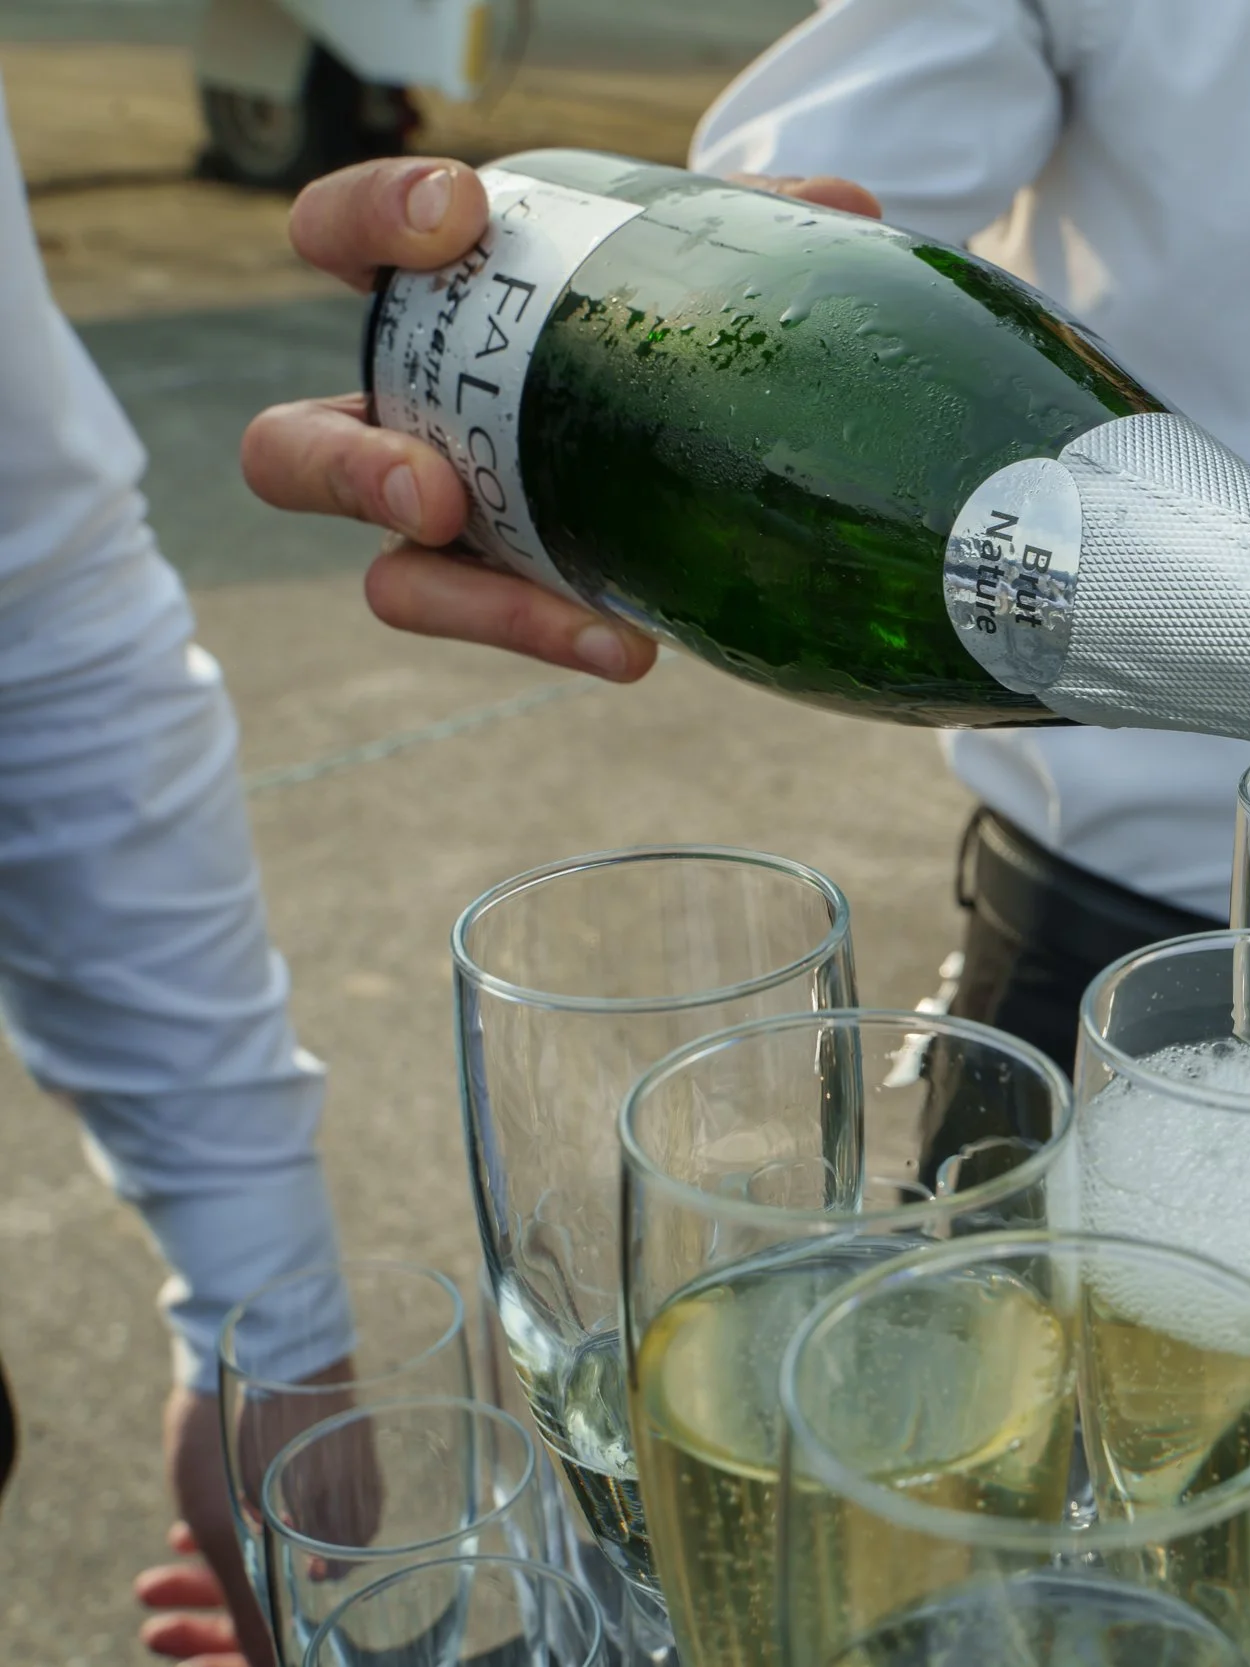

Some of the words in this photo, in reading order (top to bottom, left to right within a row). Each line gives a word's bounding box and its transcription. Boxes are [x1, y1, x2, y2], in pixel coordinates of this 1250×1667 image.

[456, 272, 537, 560] FALCOU
[975, 509, 1020, 635] Nature
[1015, 544, 1053, 628] Brut
